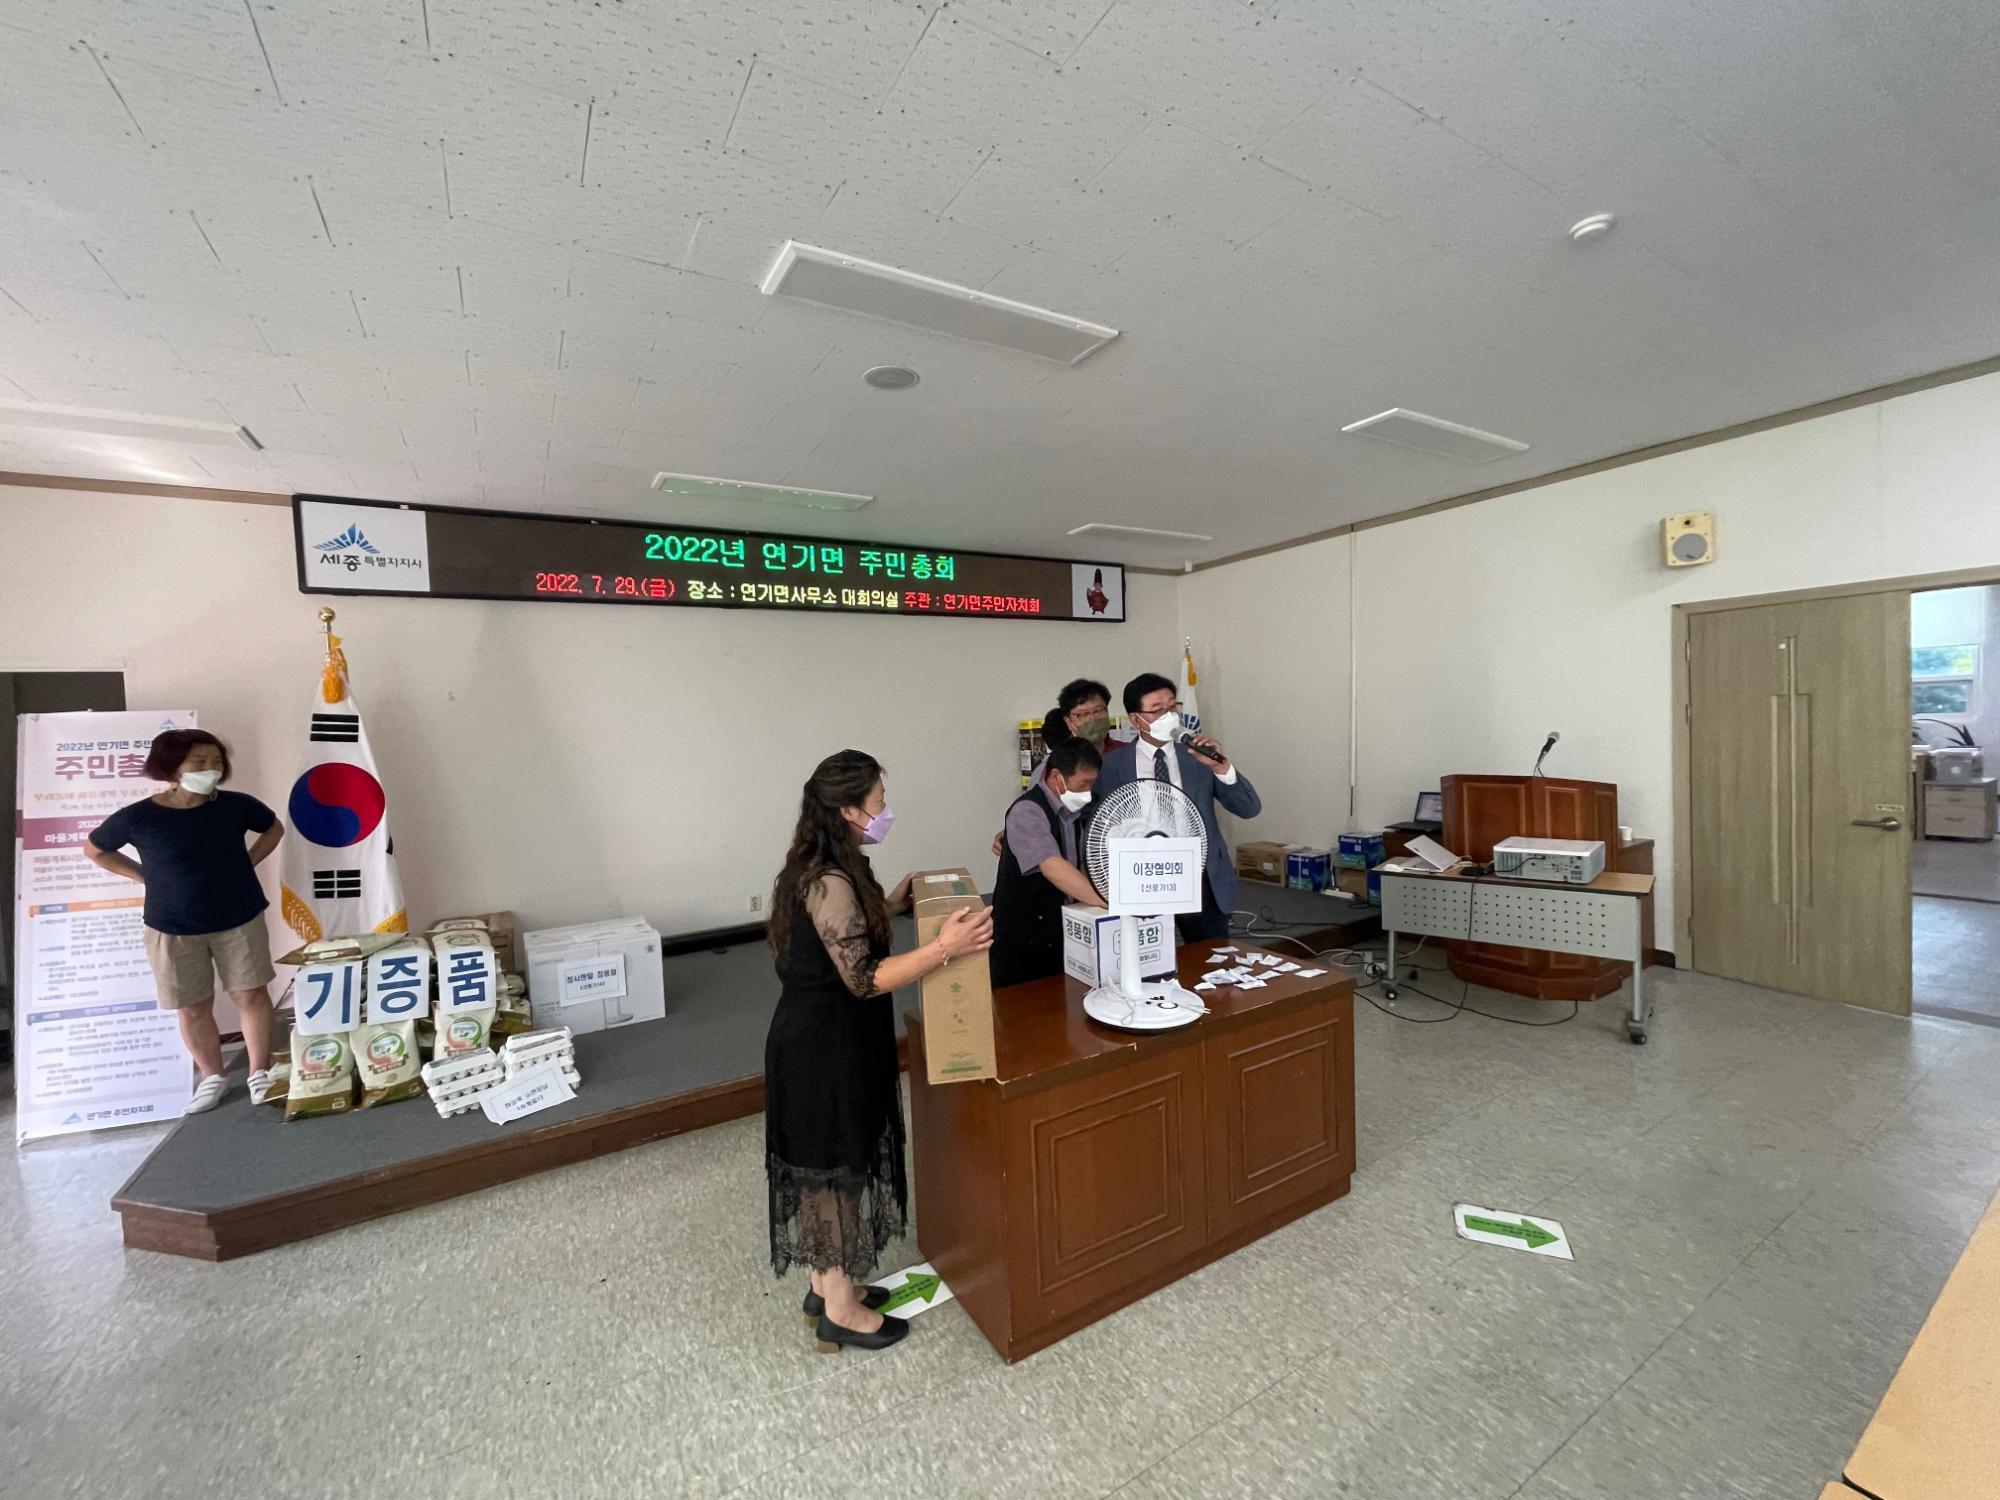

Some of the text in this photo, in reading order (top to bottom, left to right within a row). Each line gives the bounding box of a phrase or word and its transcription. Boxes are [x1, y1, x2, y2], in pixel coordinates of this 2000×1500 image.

[645, 534, 955, 581] 2022년 연기면 주민총회
[536, 572, 583, 593] 2022.
[591, 575, 606, 594] 7.
[615, 576, 676, 598] 29.(금)
[687, 580, 724, 599] 장소
[740, 582, 837, 605] 연기면사무소
[842, 588, 899, 608] 대회의실
[904, 591, 931, 609] 주관
[943, 594, 1041, 613] 연기면주민자치회
[56, 742, 94, 751] 2022년
[97, 741, 129, 750] 연기면
[55, 754, 145, 780] 주민총
[44, 831, 89, 843] 마을계획
[1133, 862, 1184, 876] 이장협의회
[1065, 918, 1092, 944] 경품함
[304, 951, 489, 1024] 기증품
